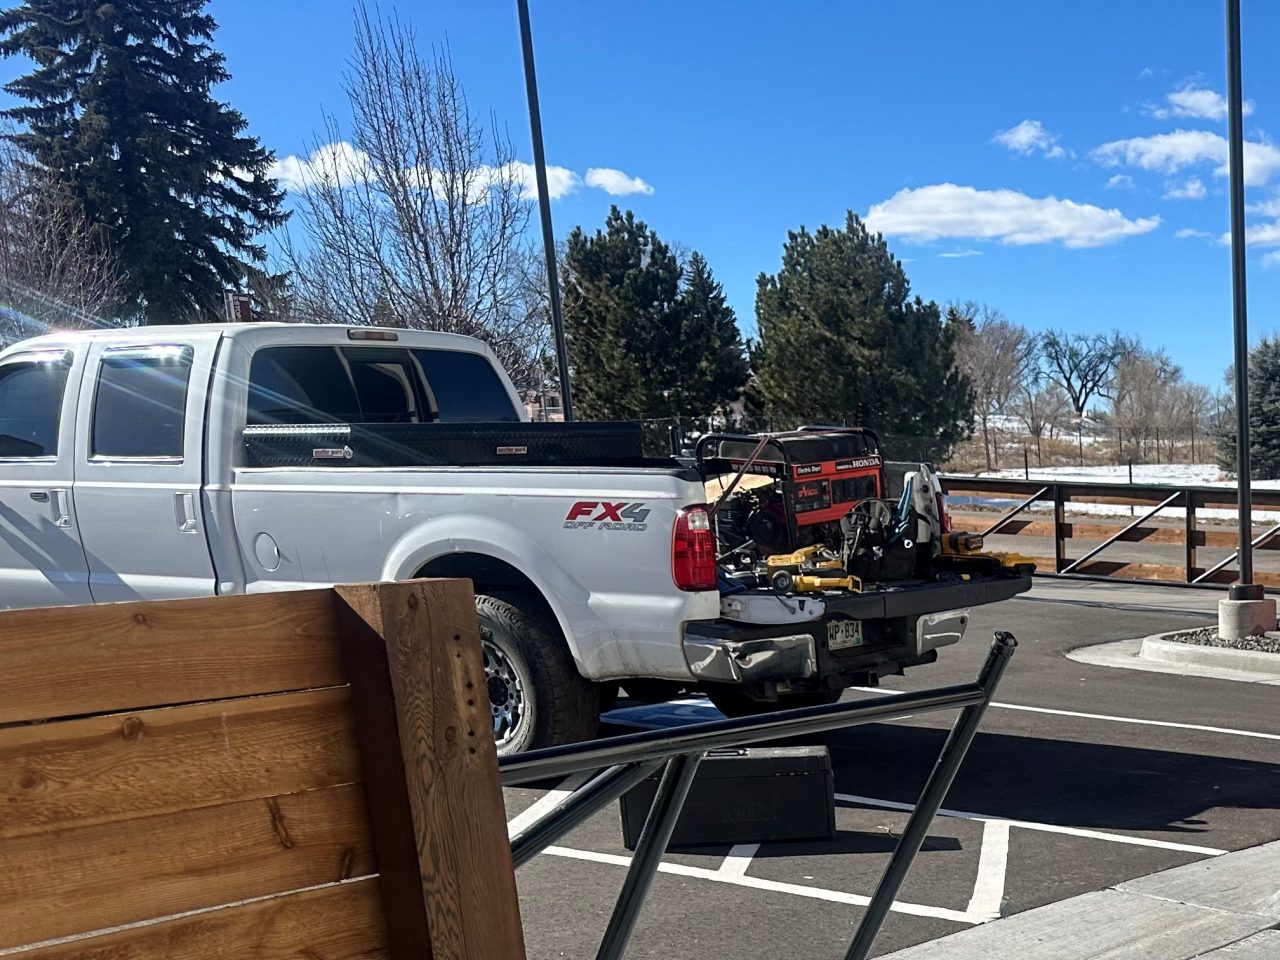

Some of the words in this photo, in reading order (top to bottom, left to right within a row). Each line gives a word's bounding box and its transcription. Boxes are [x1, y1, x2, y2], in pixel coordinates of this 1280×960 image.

[852, 458, 880, 468] HONDA
[565, 501, 651, 522] FX4
[563, 521, 596, 530] OFF
[598, 521, 648, 532] ROAD
